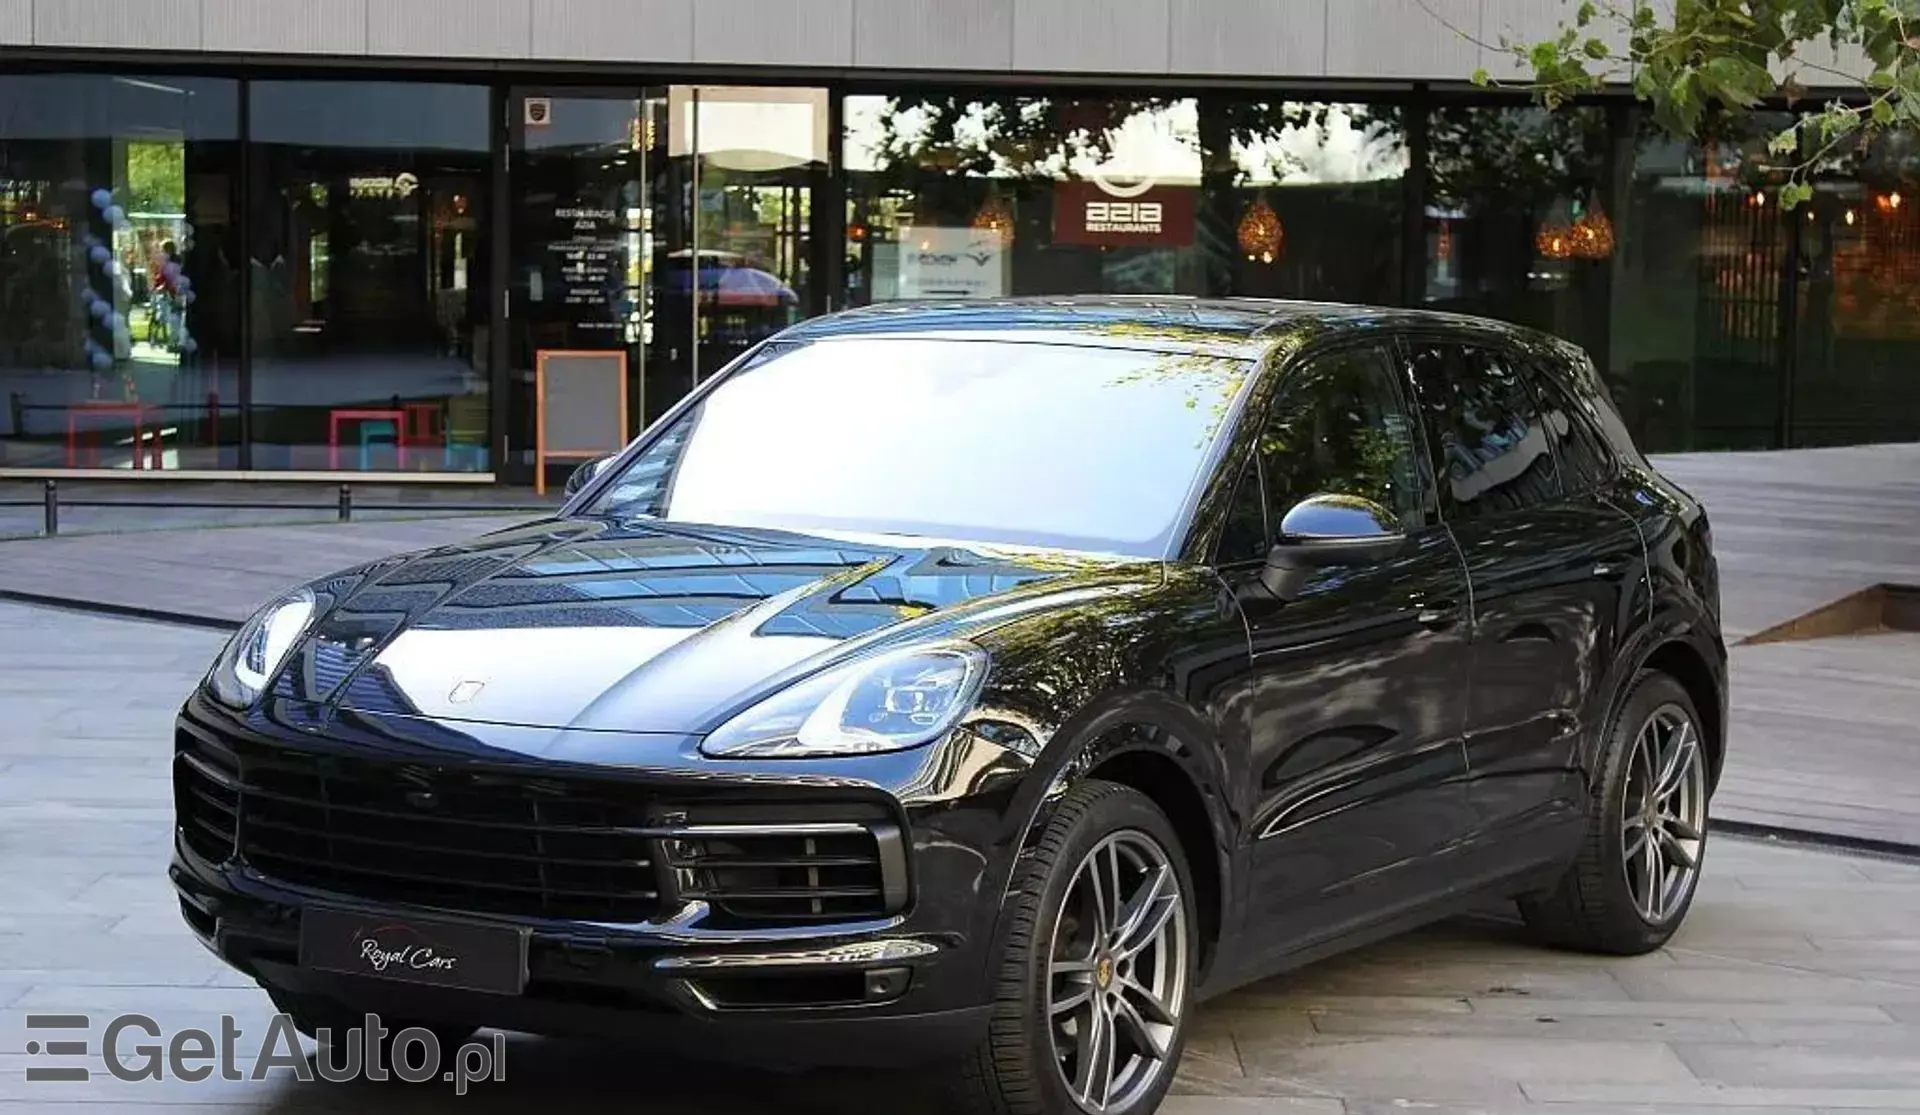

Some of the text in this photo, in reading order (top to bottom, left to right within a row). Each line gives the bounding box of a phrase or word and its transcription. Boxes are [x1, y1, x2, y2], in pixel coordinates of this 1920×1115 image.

[1086, 223, 1162, 233] RESTAURANTS
[360, 938, 457, 970] Royal Cars
